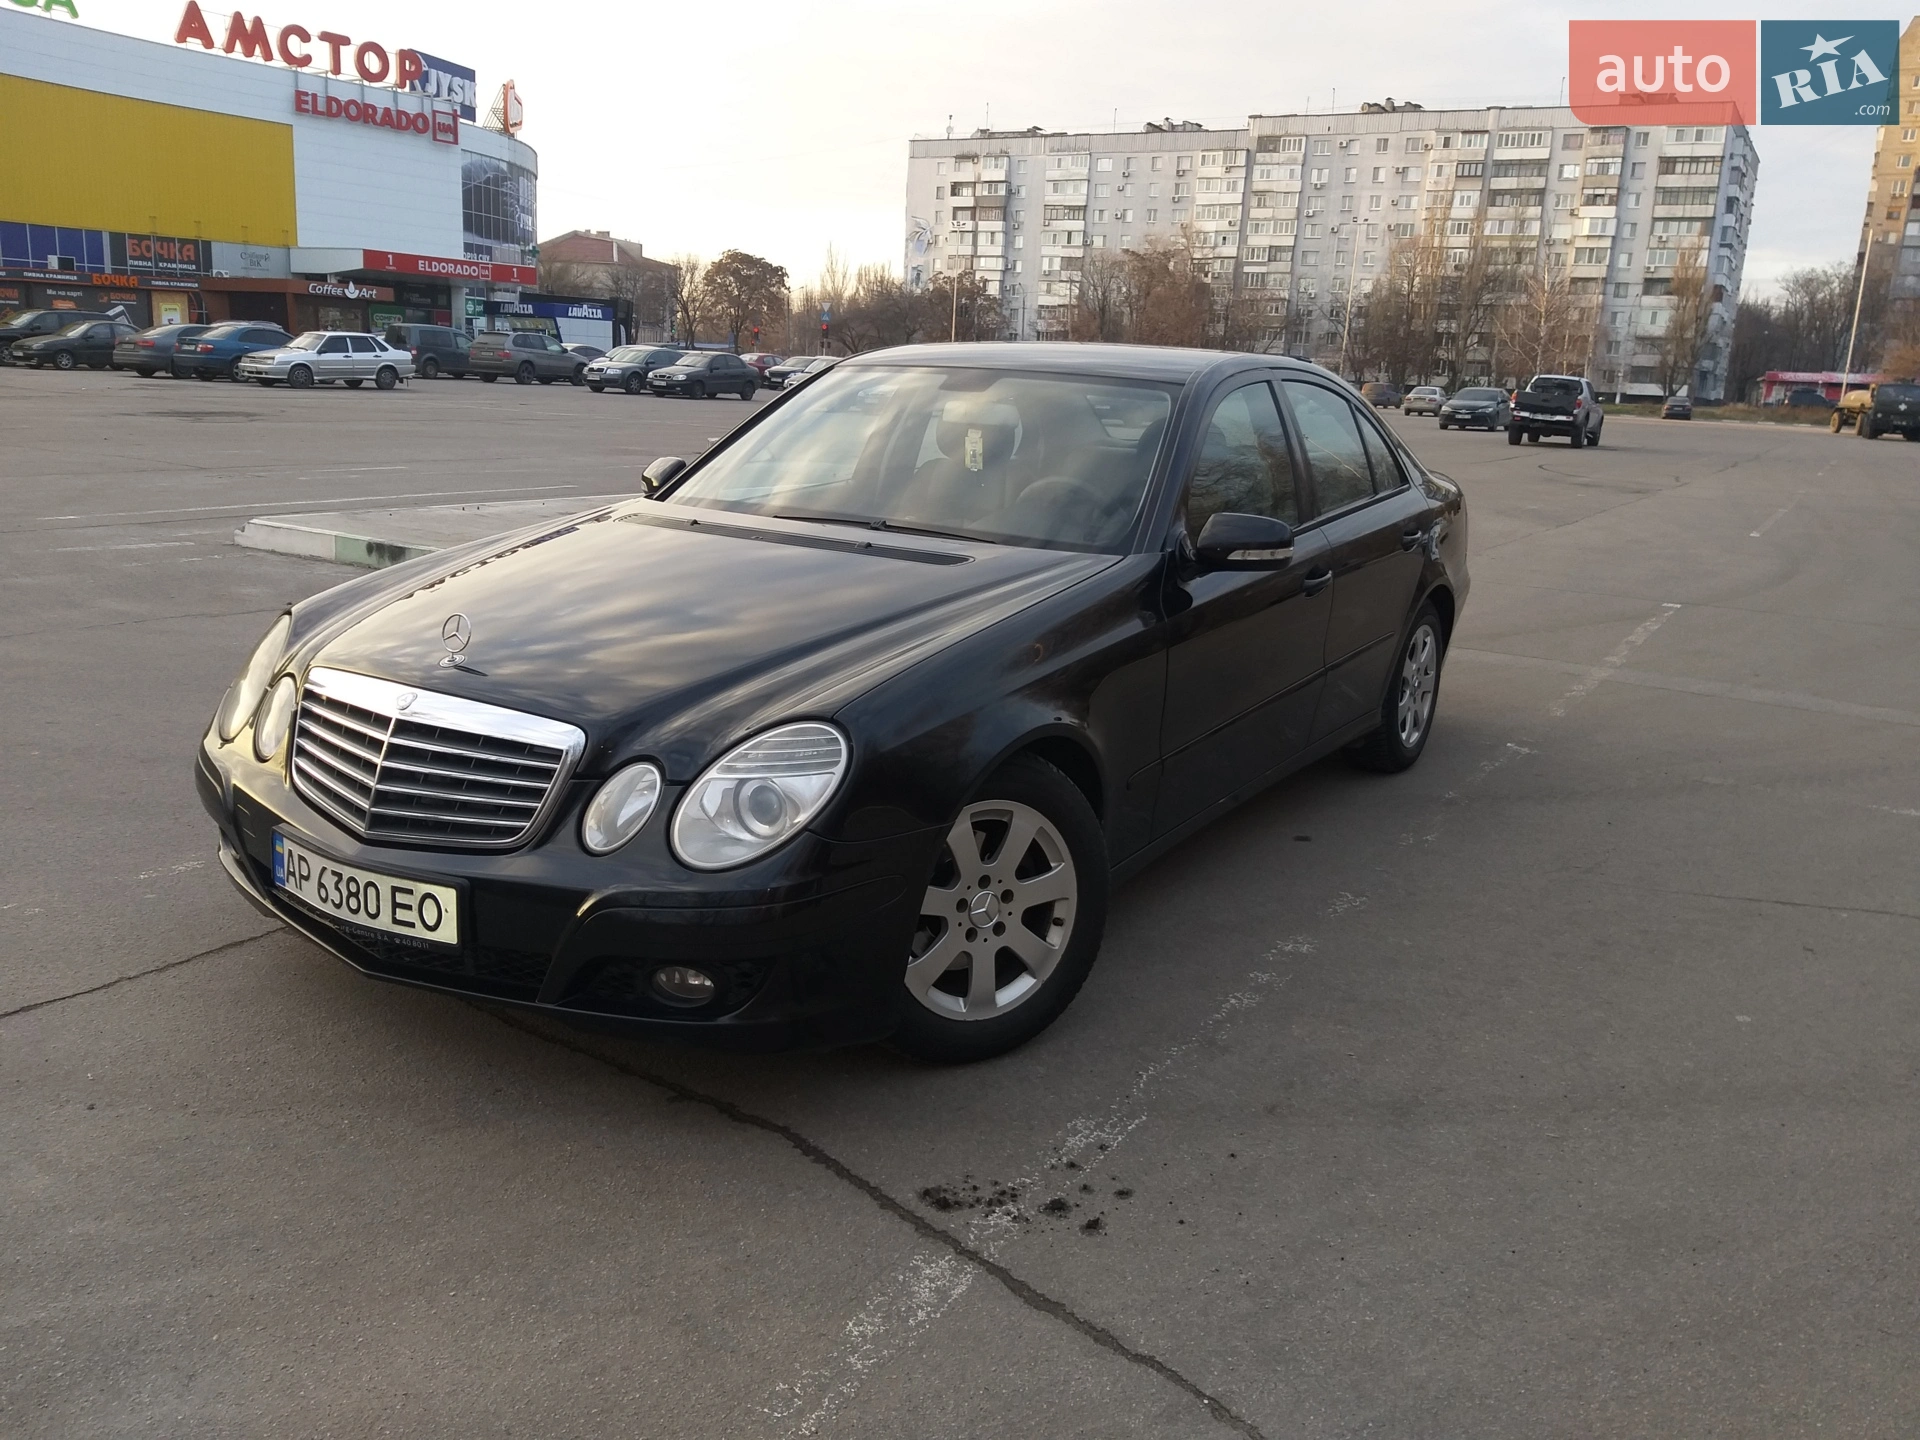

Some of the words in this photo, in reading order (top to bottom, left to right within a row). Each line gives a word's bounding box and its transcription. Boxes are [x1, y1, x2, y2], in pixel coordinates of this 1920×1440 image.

[174, 0, 423, 89] АМСТОР
[425, 68, 478, 108] JYSK
[294, 89, 430, 135] ELDORADO
[437, 121, 454, 136] UA
[127, 238, 195, 261] БОЧКА
[159, 262, 196, 270] КРАМНИЦЯ
[387, 254, 393, 266] 1
[418, 260, 479, 277] ELDORADO
[512, 267, 517, 278] 1
[92, 273, 139, 288] БОЧКА
[110, 292, 137, 300] БОЧКА
[308, 283, 343, 296] Coffee
[359, 287, 377, 298] Art
[500, 301, 533, 315] LAVAZZA
[567, 304, 603, 319] LAVAZZA
[275, 864, 285, 879] UA
[286, 848, 311, 891] AP
[317, 866, 381, 920] 6380
[390, 885, 443, 932] EO
